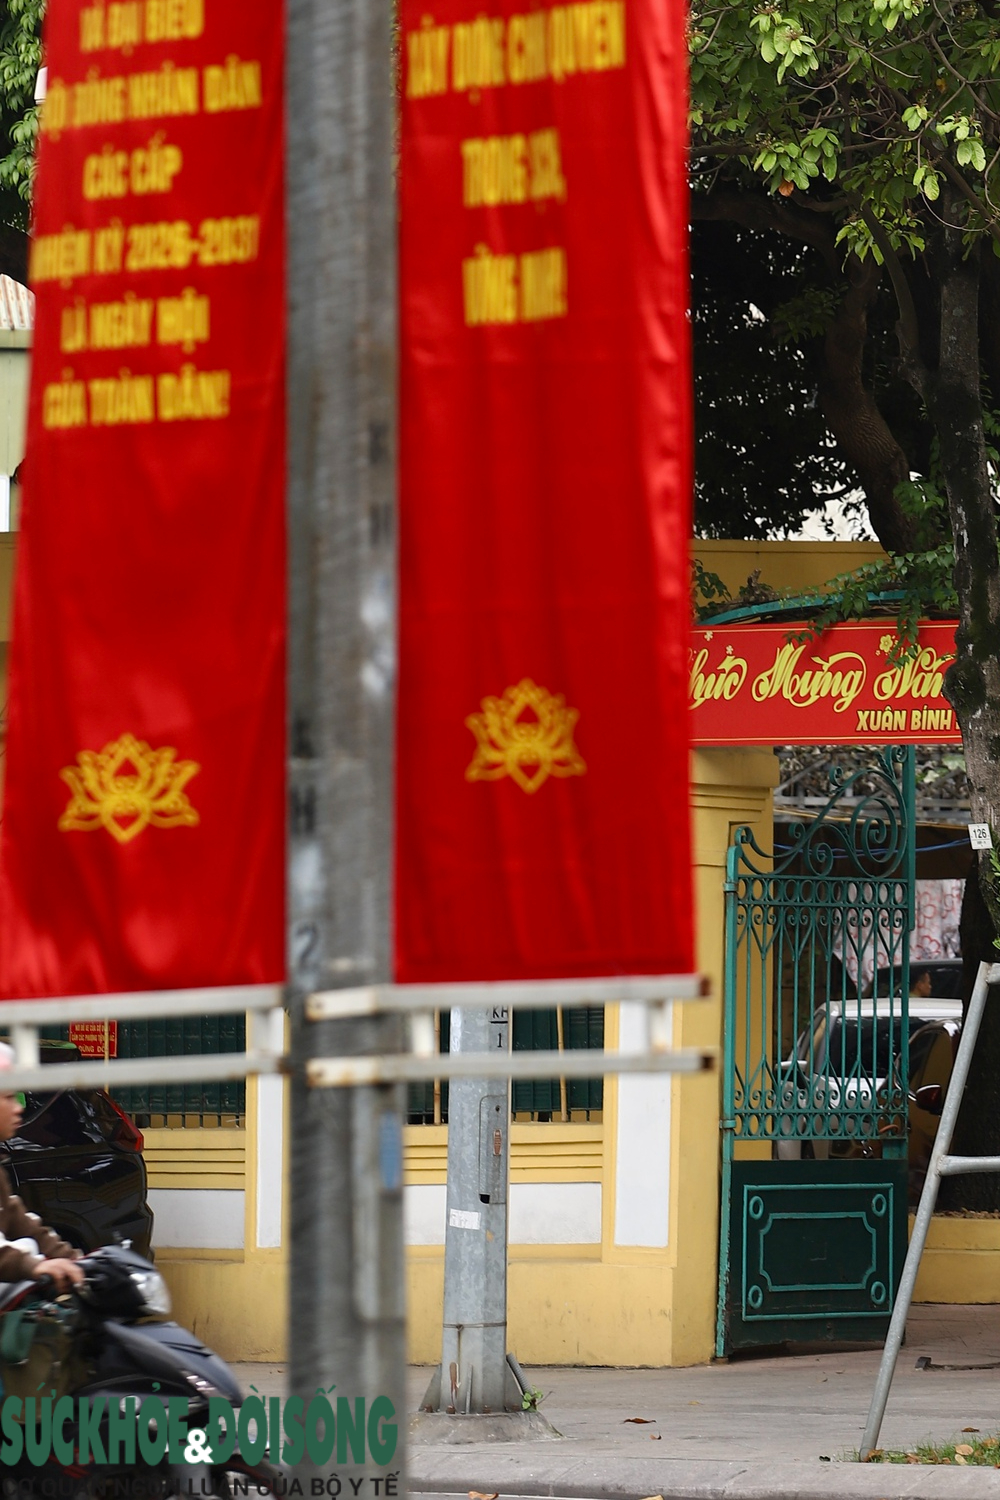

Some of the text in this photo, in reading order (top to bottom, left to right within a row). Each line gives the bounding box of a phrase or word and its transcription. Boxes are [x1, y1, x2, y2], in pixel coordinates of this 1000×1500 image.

[689, 649, 748, 710] húc
[752, 643, 867, 713] Mừng
[856, 706, 906, 731] XUÂN
[910, 705, 952, 731] BÍNH
[973, 829, 987, 839] 126
